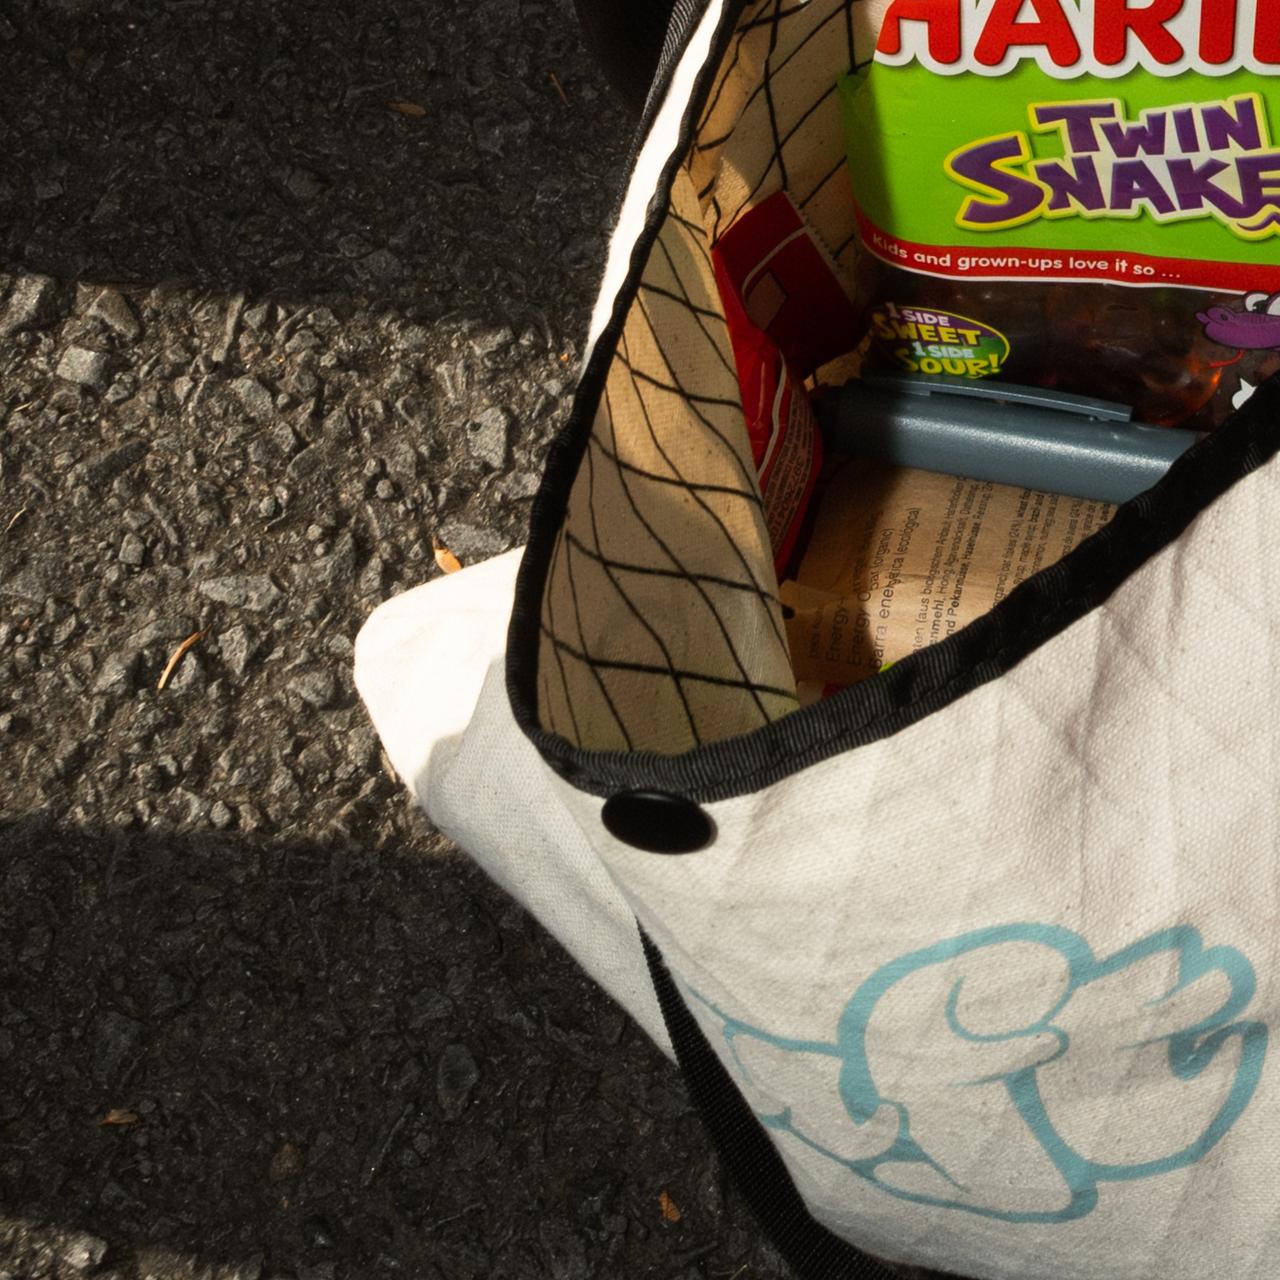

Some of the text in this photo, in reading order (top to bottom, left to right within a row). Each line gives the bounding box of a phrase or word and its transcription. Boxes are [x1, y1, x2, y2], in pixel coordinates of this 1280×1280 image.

[1031, 96, 1263, 155] TWIN
[873, 233, 908, 259] Kids
[913, 252, 951, 267] and
[957, 253, 1064, 271] grown-ups
[1069, 255, 1109, 270] love
[1115, 258, 1128, 273] it
[1132, 263, 1155, 276] so
[872, 311, 982, 345] SWEET
[902, 308, 950, 326] SIDE
[895, 349, 1001, 377] SOUR!
[912, 340, 975, 359] 1 SIDE
